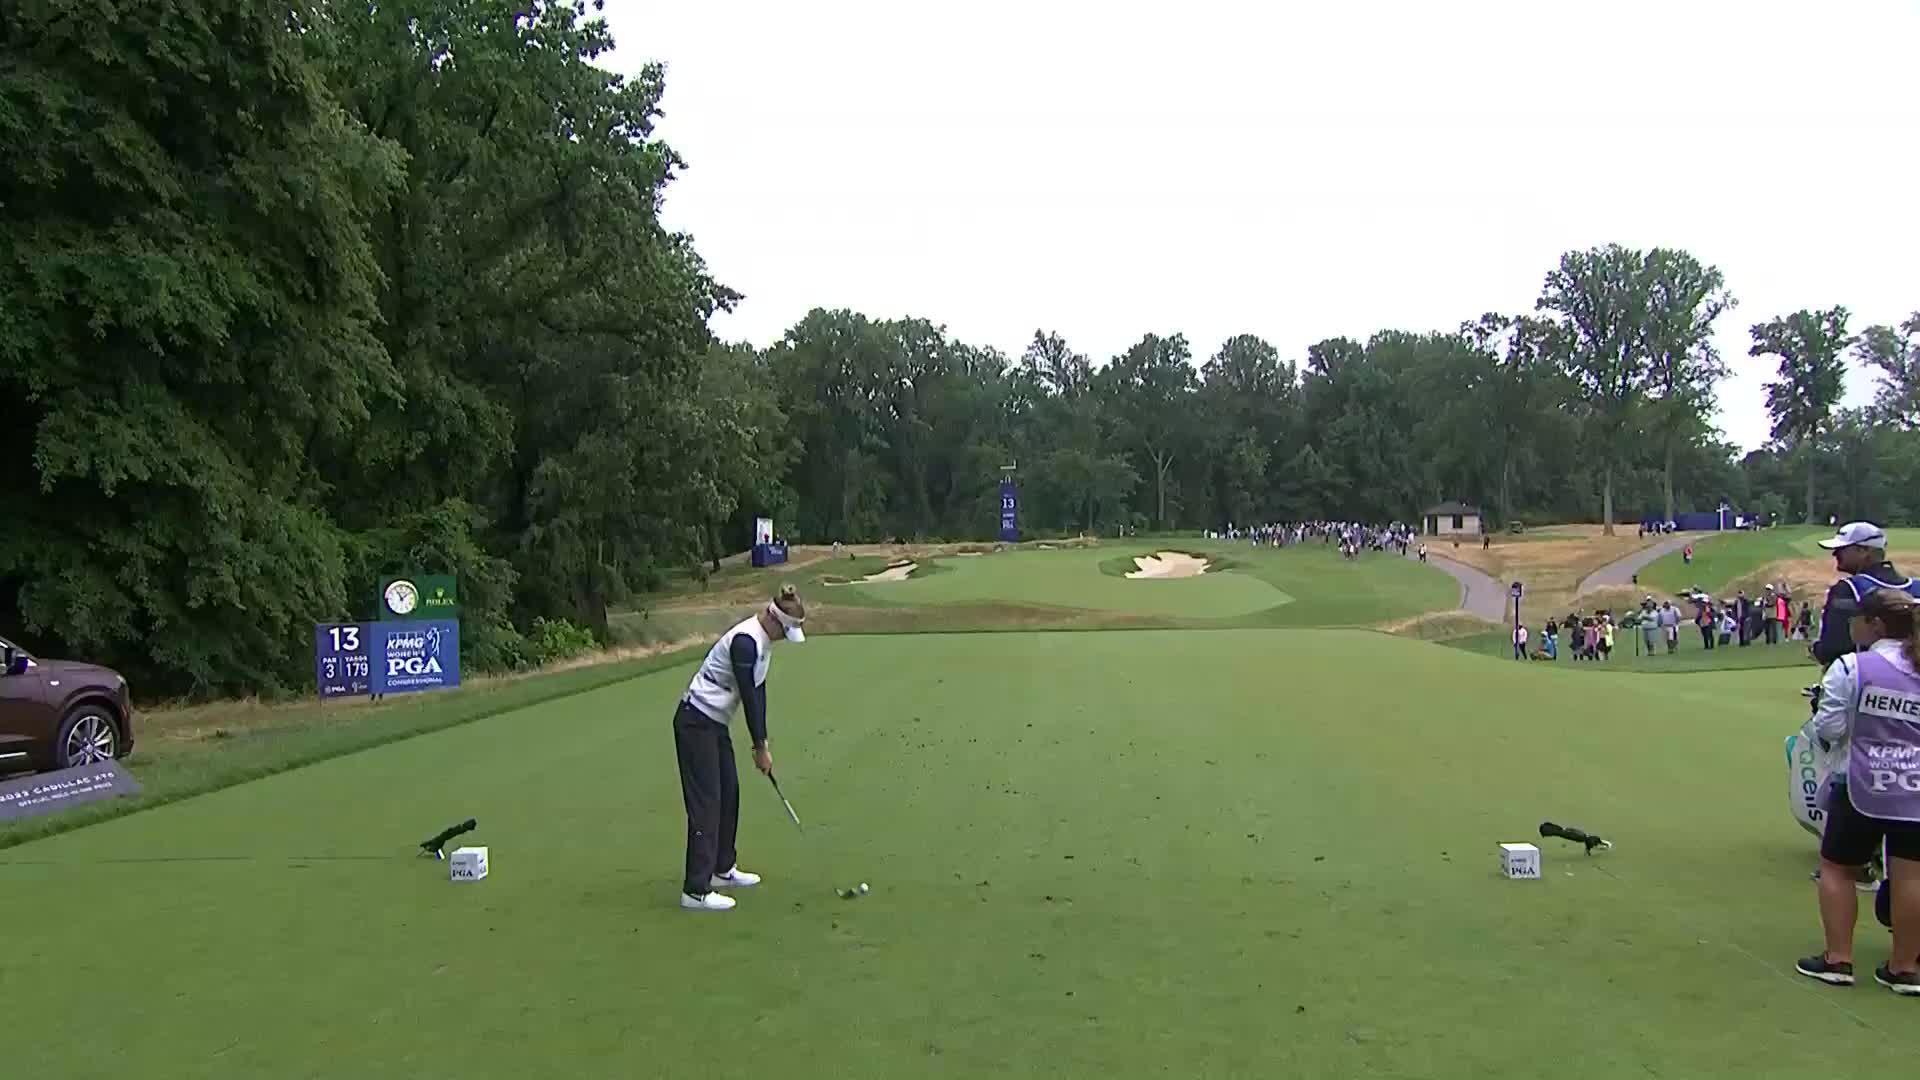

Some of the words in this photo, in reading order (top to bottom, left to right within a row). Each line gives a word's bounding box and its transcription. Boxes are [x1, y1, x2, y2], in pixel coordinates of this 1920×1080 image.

[1002, 498, 1015, 509] 13
[329, 627, 360, 651] 13
[387, 637, 425, 649] KPMG
[325, 663, 335, 679] 3
[346, 662, 369, 677] 179
[387, 656, 442, 676] PGA
